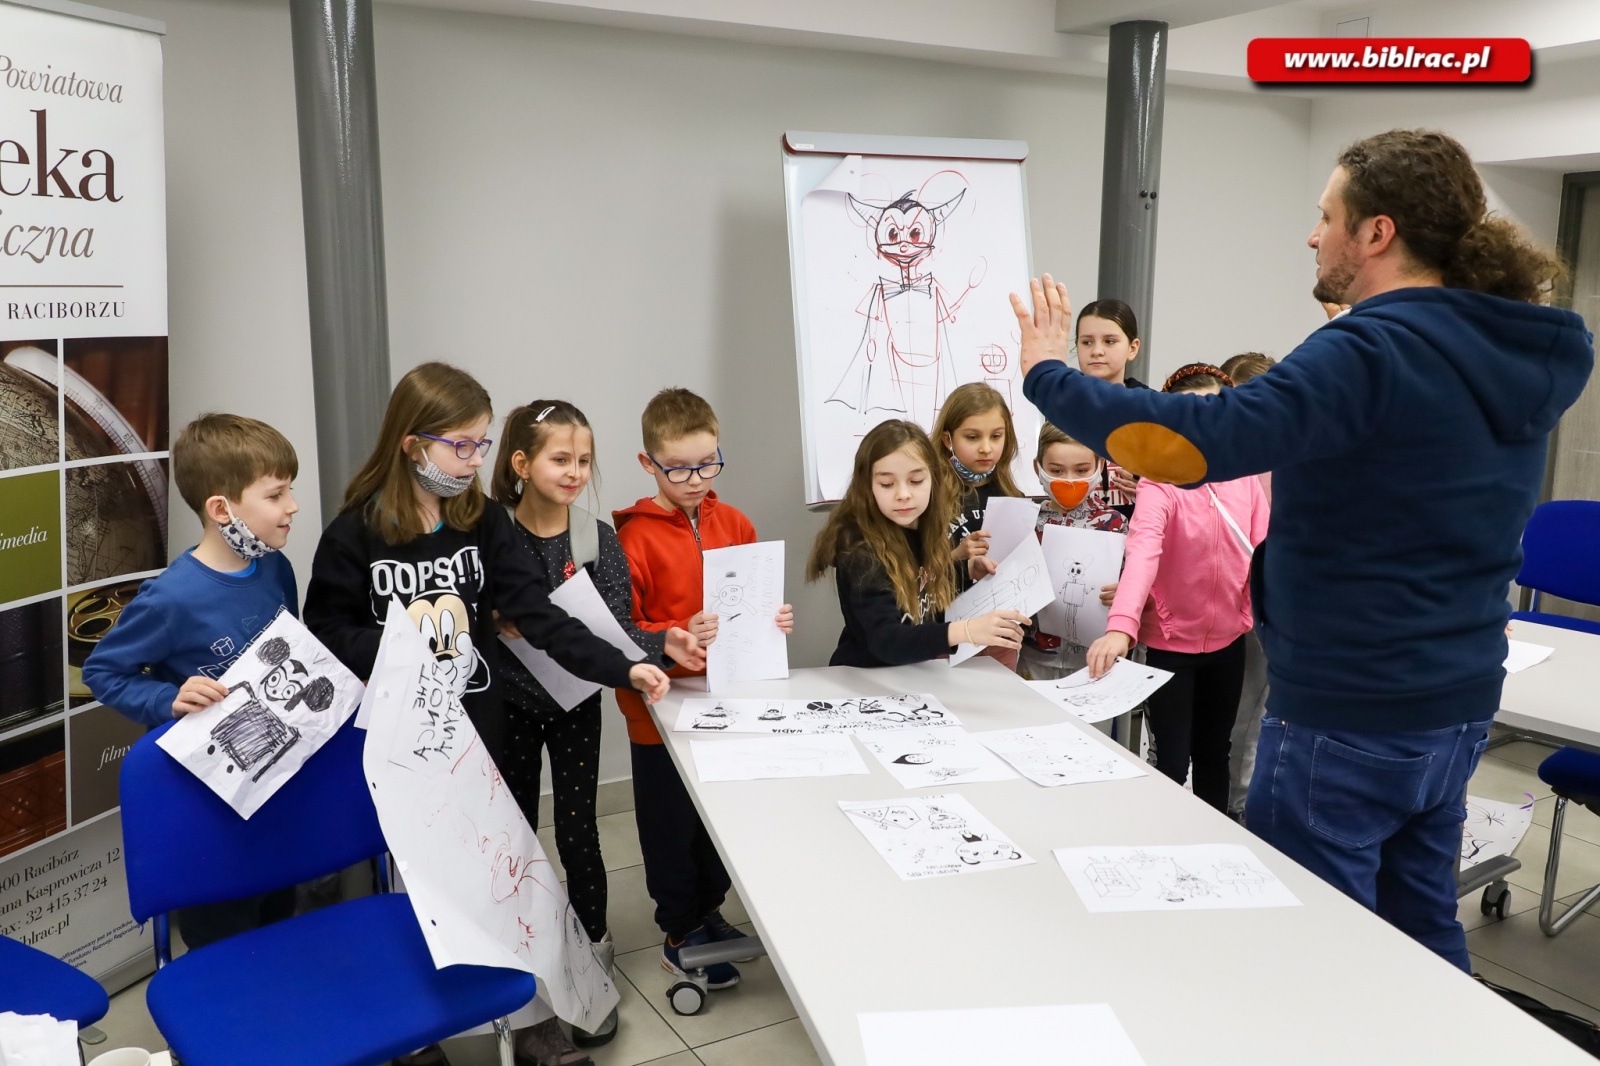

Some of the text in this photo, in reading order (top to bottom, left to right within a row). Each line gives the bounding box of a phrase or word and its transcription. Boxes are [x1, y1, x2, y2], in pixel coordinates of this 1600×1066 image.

[0, 208, 95, 264] czna
[7, 301, 126, 320] RACIBORZU
[0, 850, 80, 894] 00 Racibórz
[26, 860, 102, 904] Kasprowicza
[105, 847, 121, 864] 12
[25, 906, 43, 926] 32
[46, 892, 70, 914] 415
[73, 883, 89, 902] 37
[92, 875, 108, 893] 24
[20, 913, 71, 947] blrac.pl
